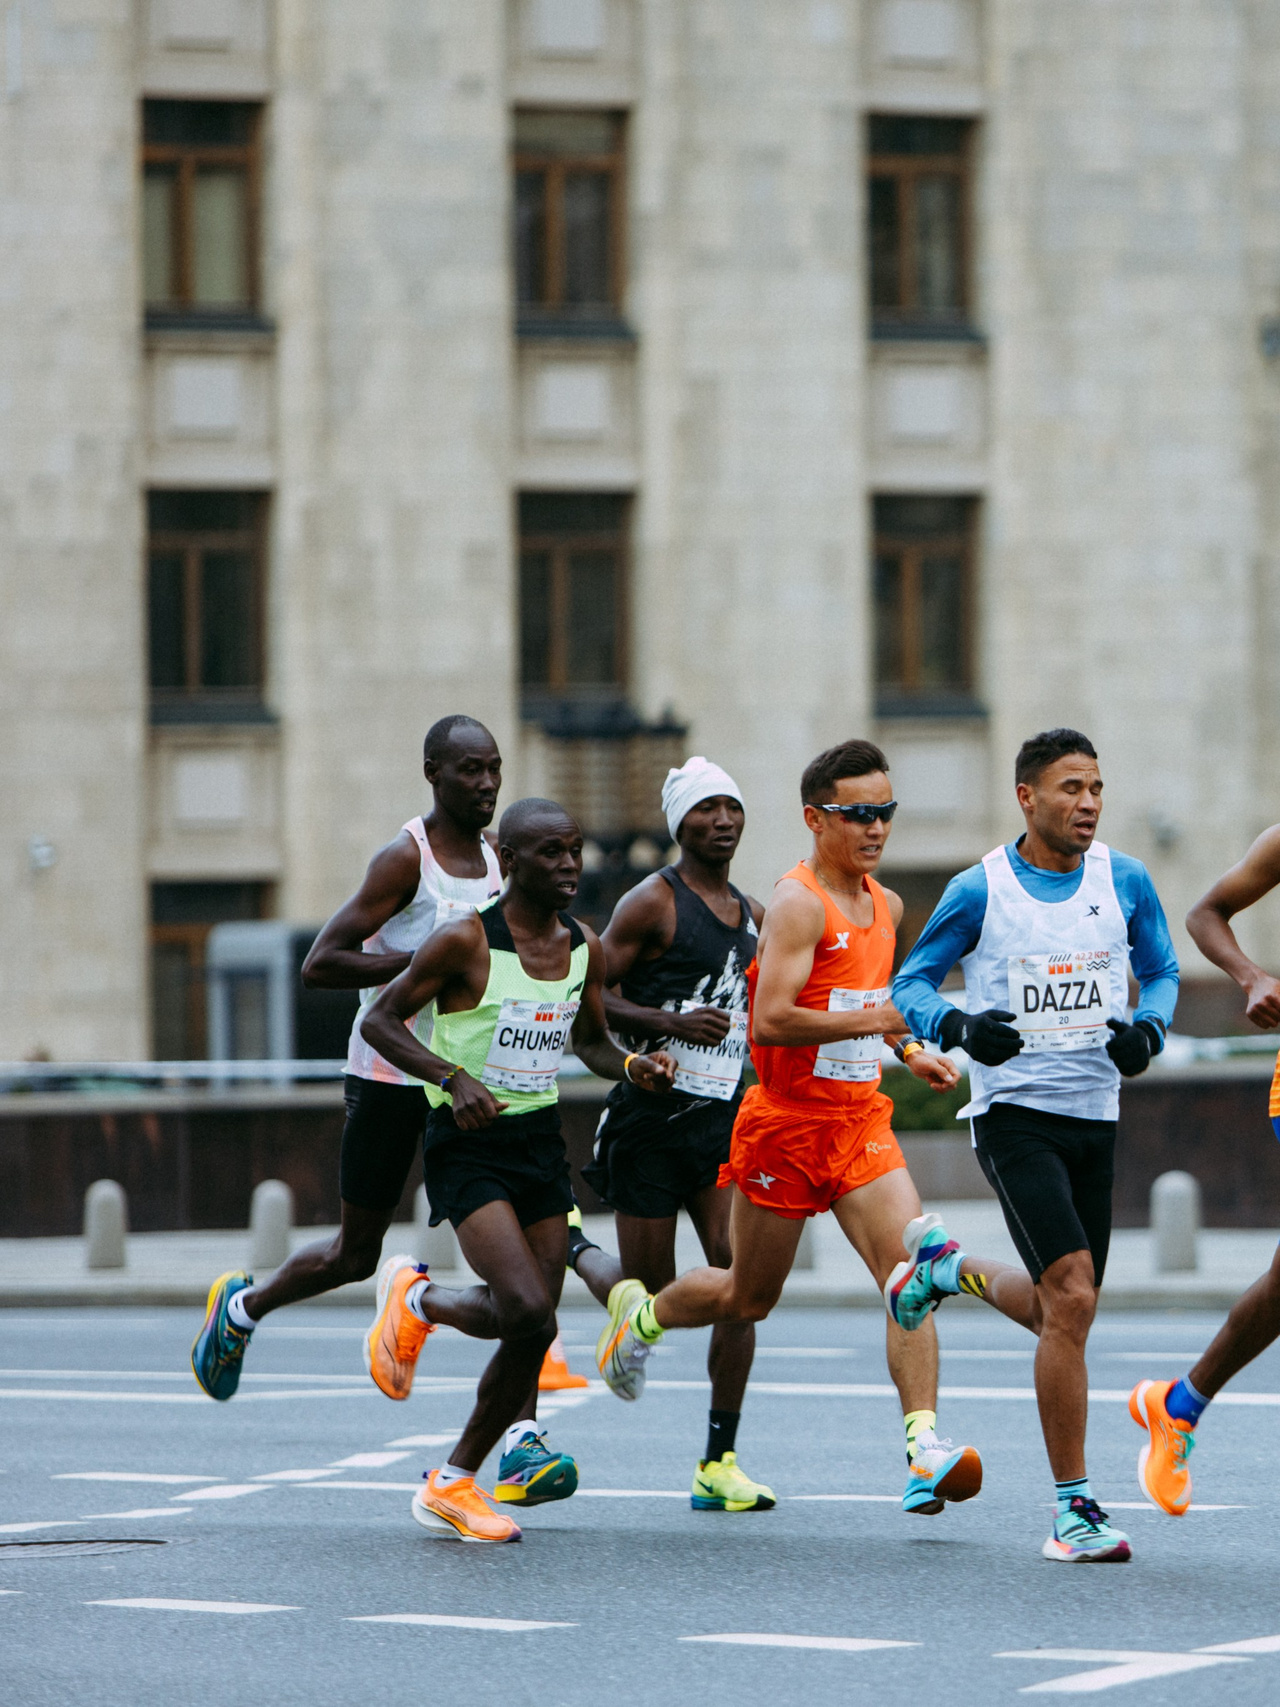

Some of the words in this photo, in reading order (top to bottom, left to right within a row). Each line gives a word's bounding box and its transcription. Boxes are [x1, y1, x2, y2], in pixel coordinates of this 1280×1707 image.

[1075, 951, 1093, 961] 42,2
[1094, 950, 1109, 960] KM
[1023, 980, 1102, 1013] DAZZA
[1059, 1016, 1069, 1025] 20
